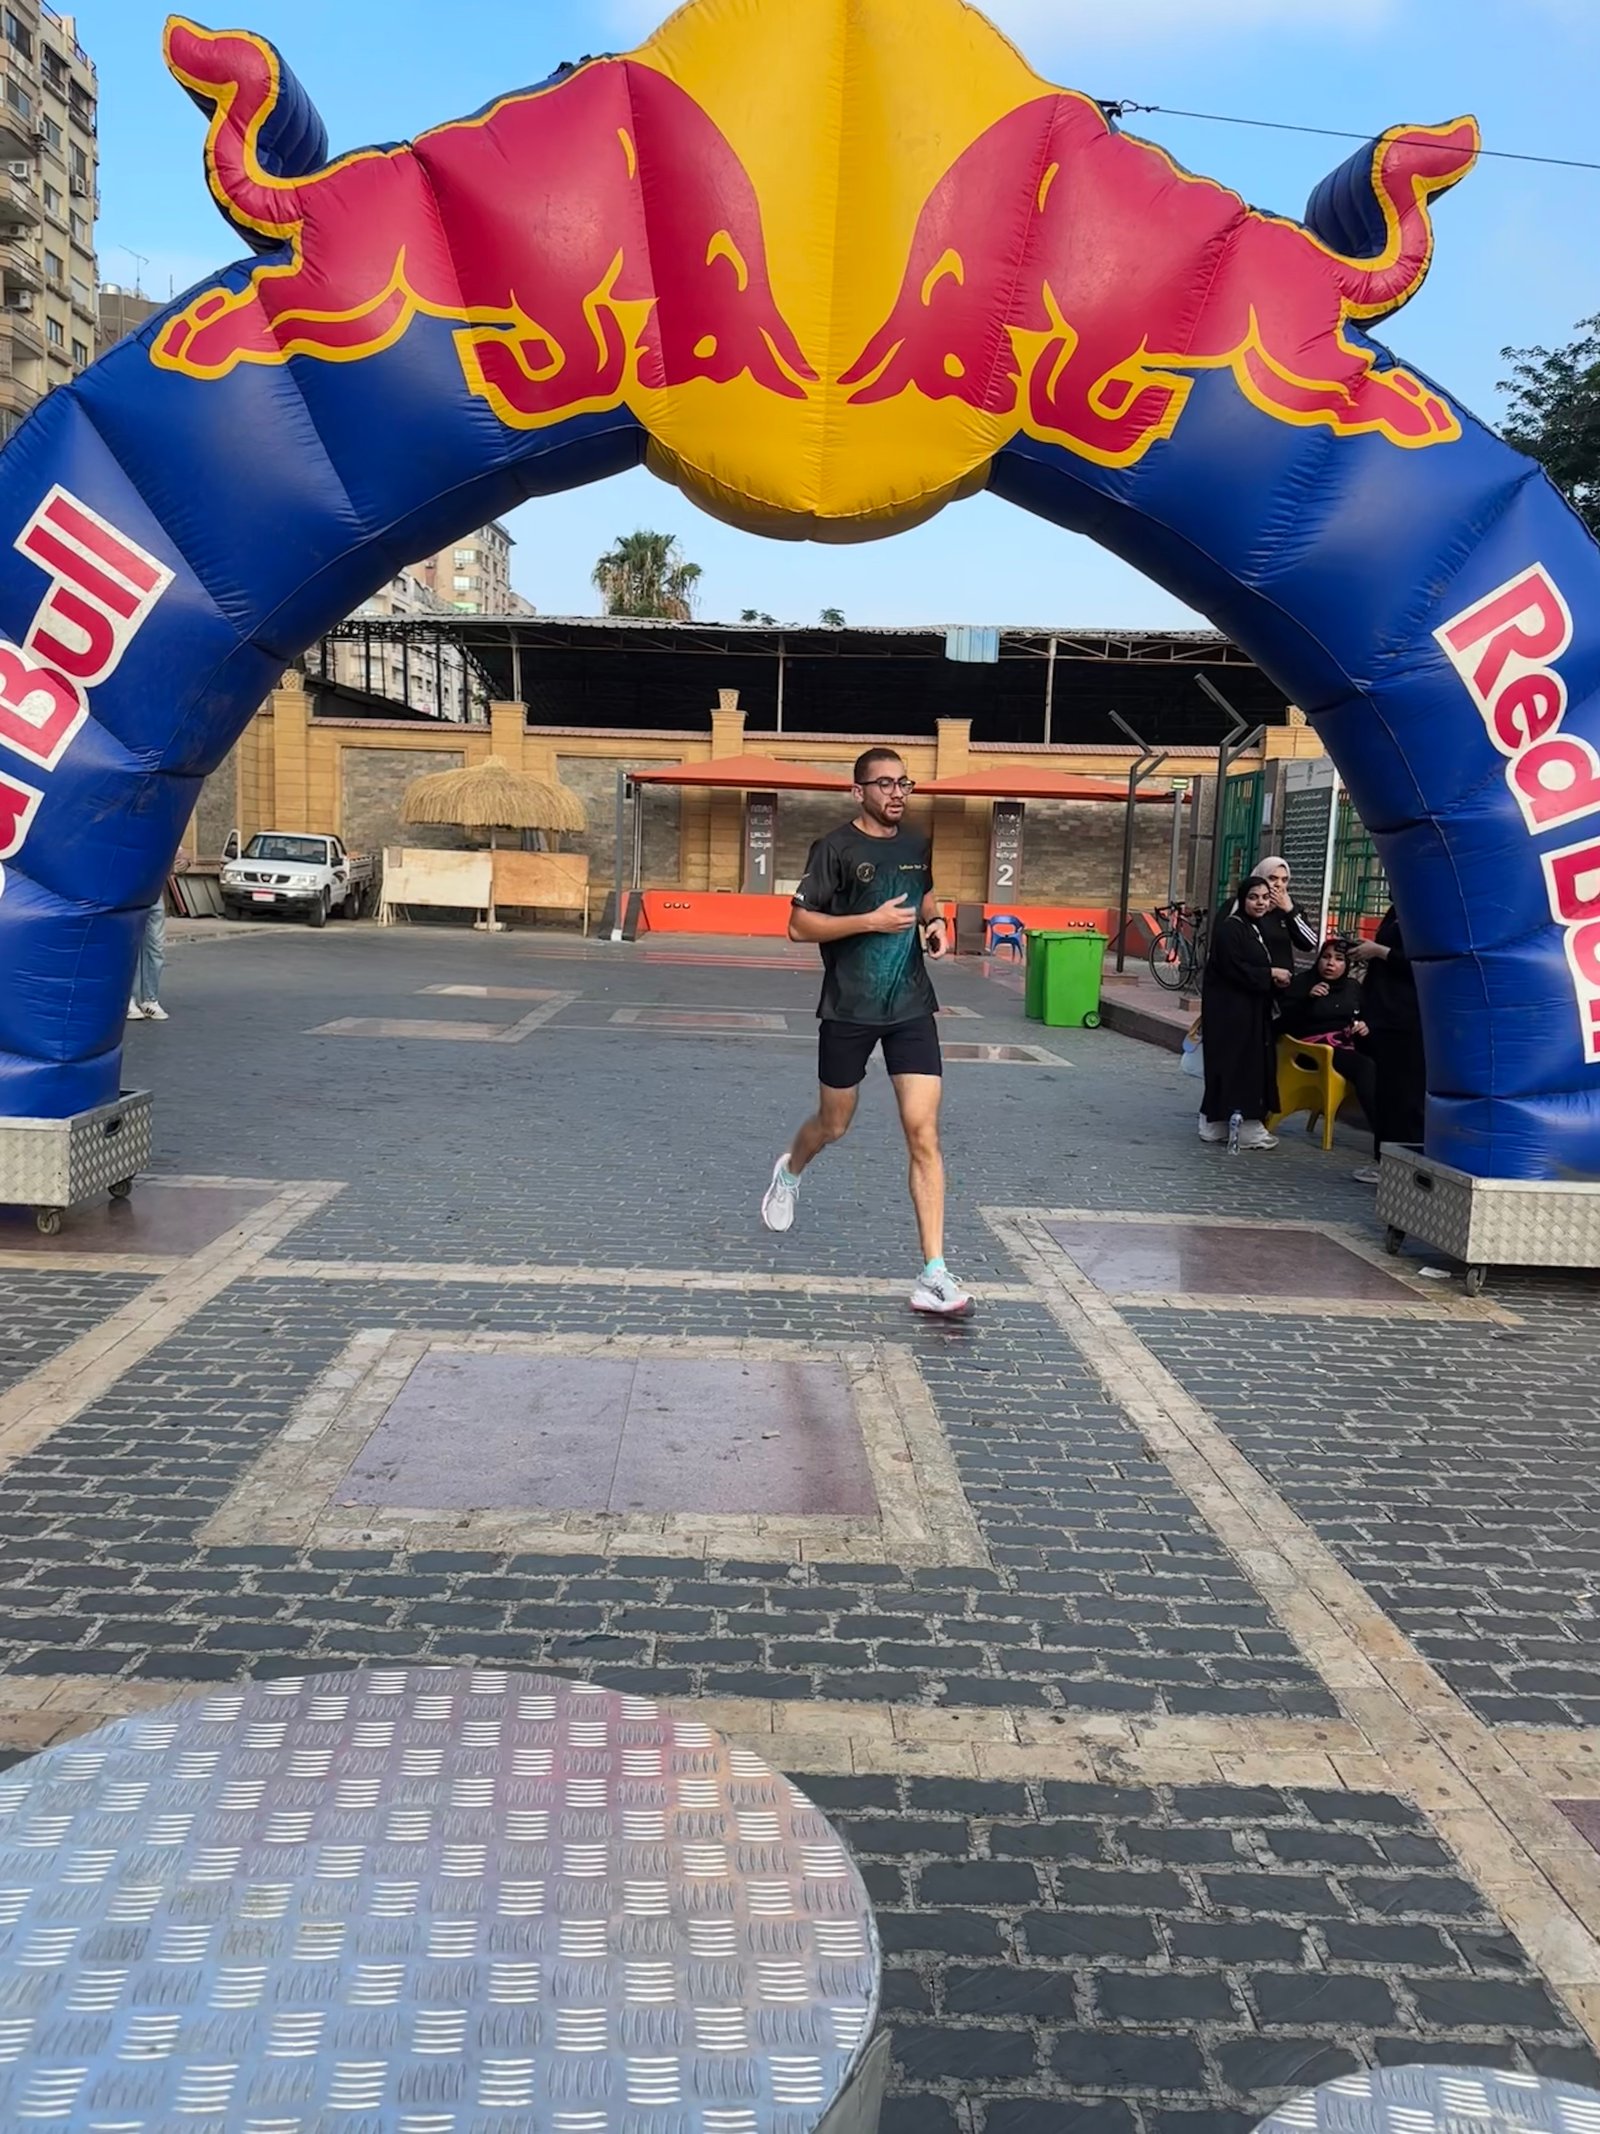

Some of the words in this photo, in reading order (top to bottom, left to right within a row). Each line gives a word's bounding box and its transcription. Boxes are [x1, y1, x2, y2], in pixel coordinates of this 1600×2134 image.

[0, 488, 170, 765] Bull
[1438, 566, 1600, 830] Red
[754, 853, 766, 875] 1
[996, 864, 1014, 886] 2
